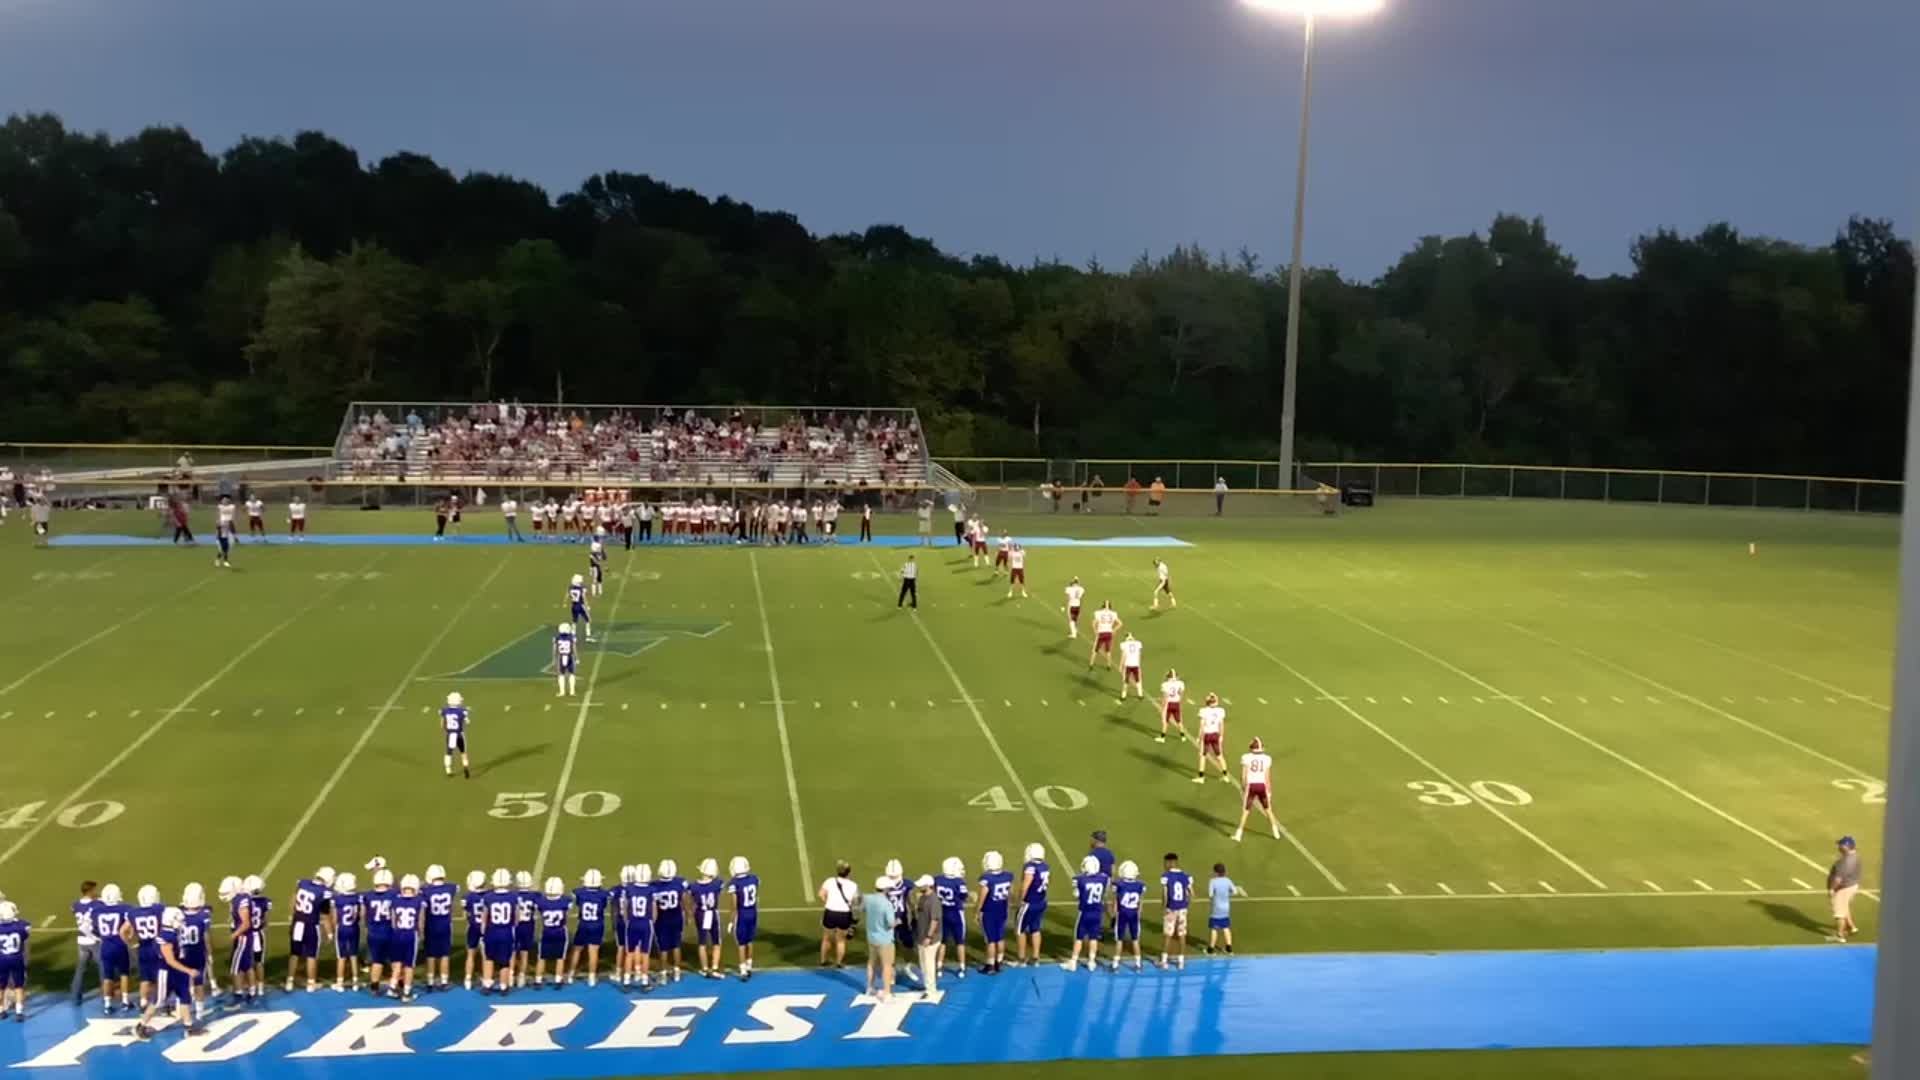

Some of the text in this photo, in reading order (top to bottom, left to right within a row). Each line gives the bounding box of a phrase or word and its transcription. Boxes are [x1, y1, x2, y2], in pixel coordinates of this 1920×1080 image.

[1250, 759, 1265, 774] 81
[967, 785, 1089, 811] 40
[1406, 780, 1533, 806] 30
[1831, 778, 1888, 804] 2
[487, 791, 622, 818] 50
[295, 888, 315, 914] 56
[655, 890, 678, 910] 50
[743, 884, 757, 907] 13
[1086, 883, 1103, 905] 79
[1121, 892, 1140, 909] 42
[1173, 882, 1184, 901] 8
[370, 899, 392, 922] 74
[430, 893, 451, 915] 62
[491, 902, 511, 924] 60
[582, 902, 598, 921] 61
[632, 896, 647, 917] 19
[98, 912, 120, 936] 67
[135, 915, 158, 939] 59
[396, 907, 416, 929] 36
[6, 989, 945, 1069] FORREST
